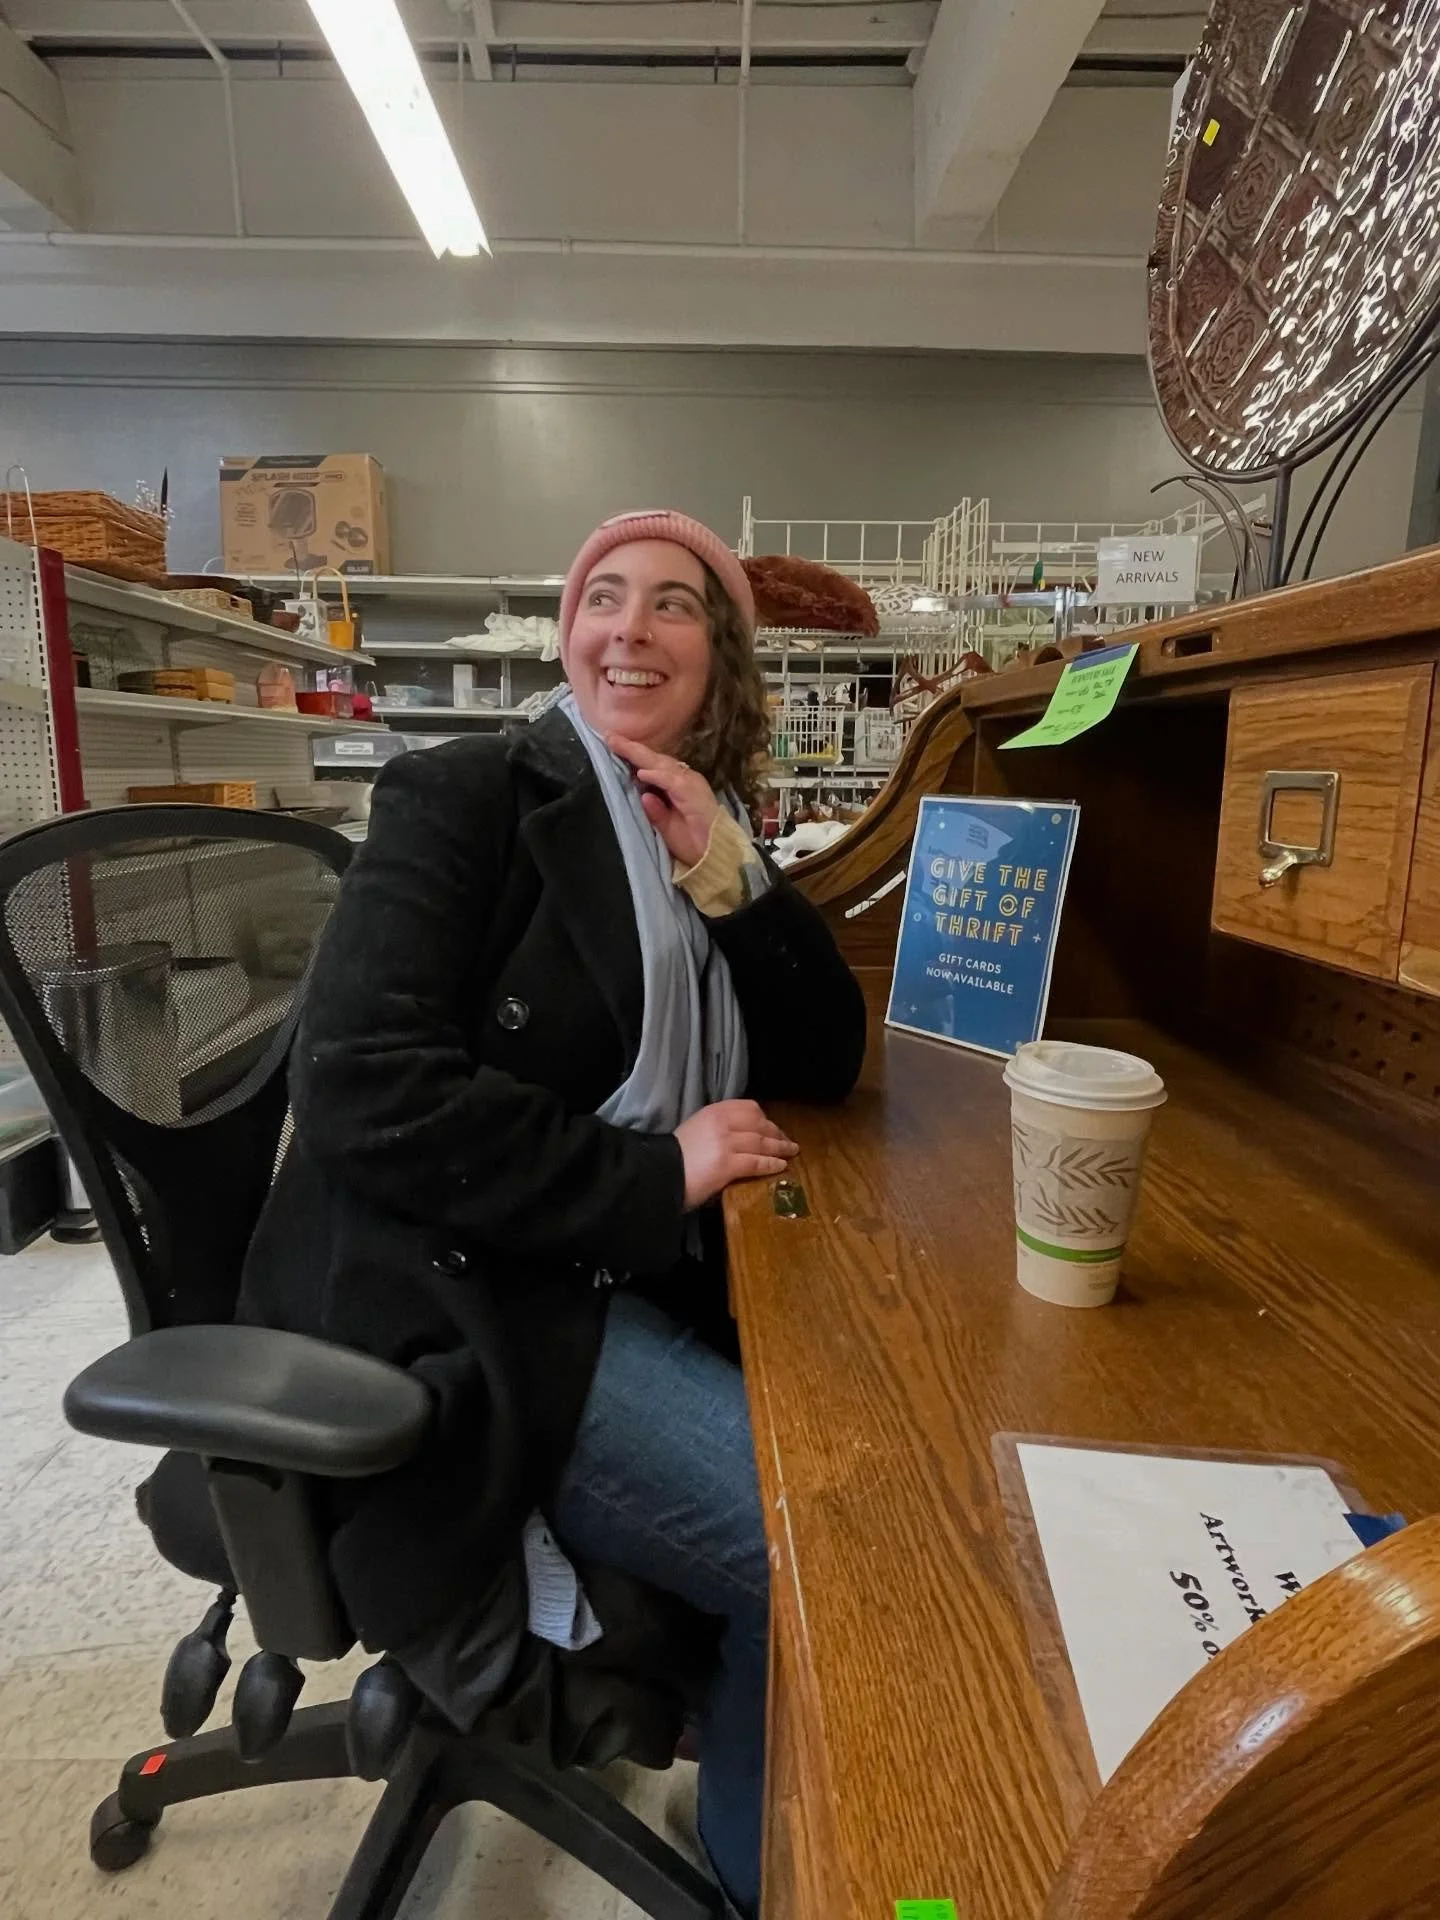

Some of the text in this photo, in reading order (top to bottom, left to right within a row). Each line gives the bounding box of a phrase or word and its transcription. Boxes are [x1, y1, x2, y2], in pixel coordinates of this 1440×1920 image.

[1133, 550, 1164, 562] NEW
[1115, 571, 1179, 584] ARRIVALS
[930, 856, 1048, 891] GIVE THE
[932, 884, 1035, 919] GIFT OF
[935, 912, 1024, 946] THRIFT
[938, 953, 1002, 974] GIFT CARDS
[926, 967, 1014, 995] NOW AVAILABLE
[1199, 1512, 1268, 1625] Artwork
[1274, 1571, 1303, 1600] W
[1169, 1570, 1221, 1661] 50% o
